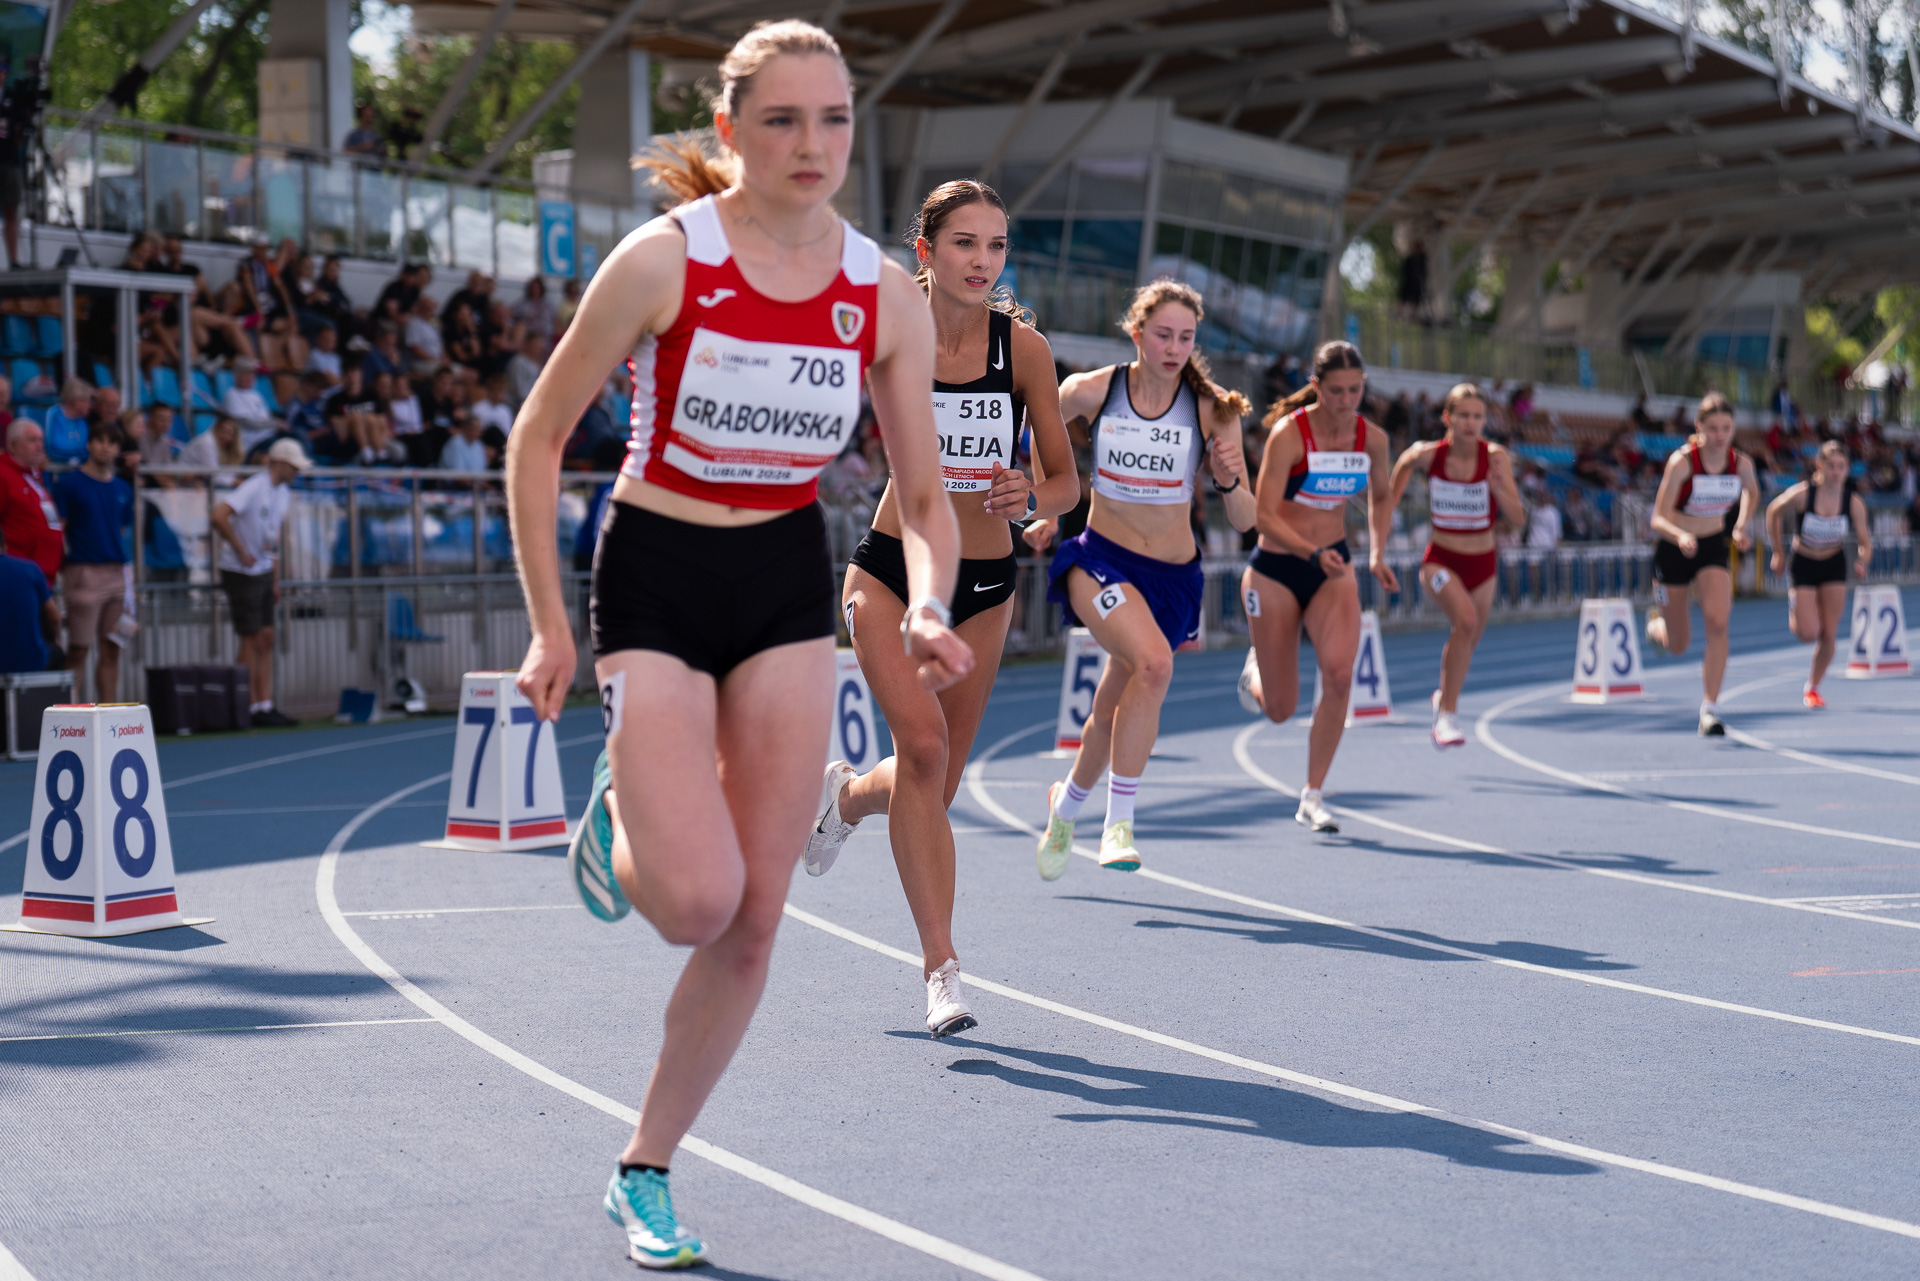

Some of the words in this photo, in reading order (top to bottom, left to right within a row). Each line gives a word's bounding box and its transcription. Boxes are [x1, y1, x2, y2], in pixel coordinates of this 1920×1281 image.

[547, 221, 570, 273] C
[789, 356, 845, 387] 708
[682, 395, 843, 441] GRABOWSKA
[958, 399, 1002, 419] 518
[1150, 427, 1181, 445] 341
[703, 465, 752, 480] LUBLIN
[951, 481, 977, 490] 2026
[1107, 449, 1174, 473] NOCEŃ
[1100, 590, 1118, 610] 6
[1582, 622, 1598, 676] 3
[1609, 621, 1632, 677] 3
[1855, 606, 1871, 656] 2
[1878, 606, 1901, 655] 2
[1357, 635, 1379, 698] 4
[1070, 655, 1099, 728] 5
[59, 725, 87, 739] polanik
[118, 723, 145, 739] polanik
[838, 679, 867, 765] 6
[464, 706, 496, 809] 7
[510, 706, 544, 809] 7
[41, 750, 85, 881] 8
[110, 748, 156, 879] 8
